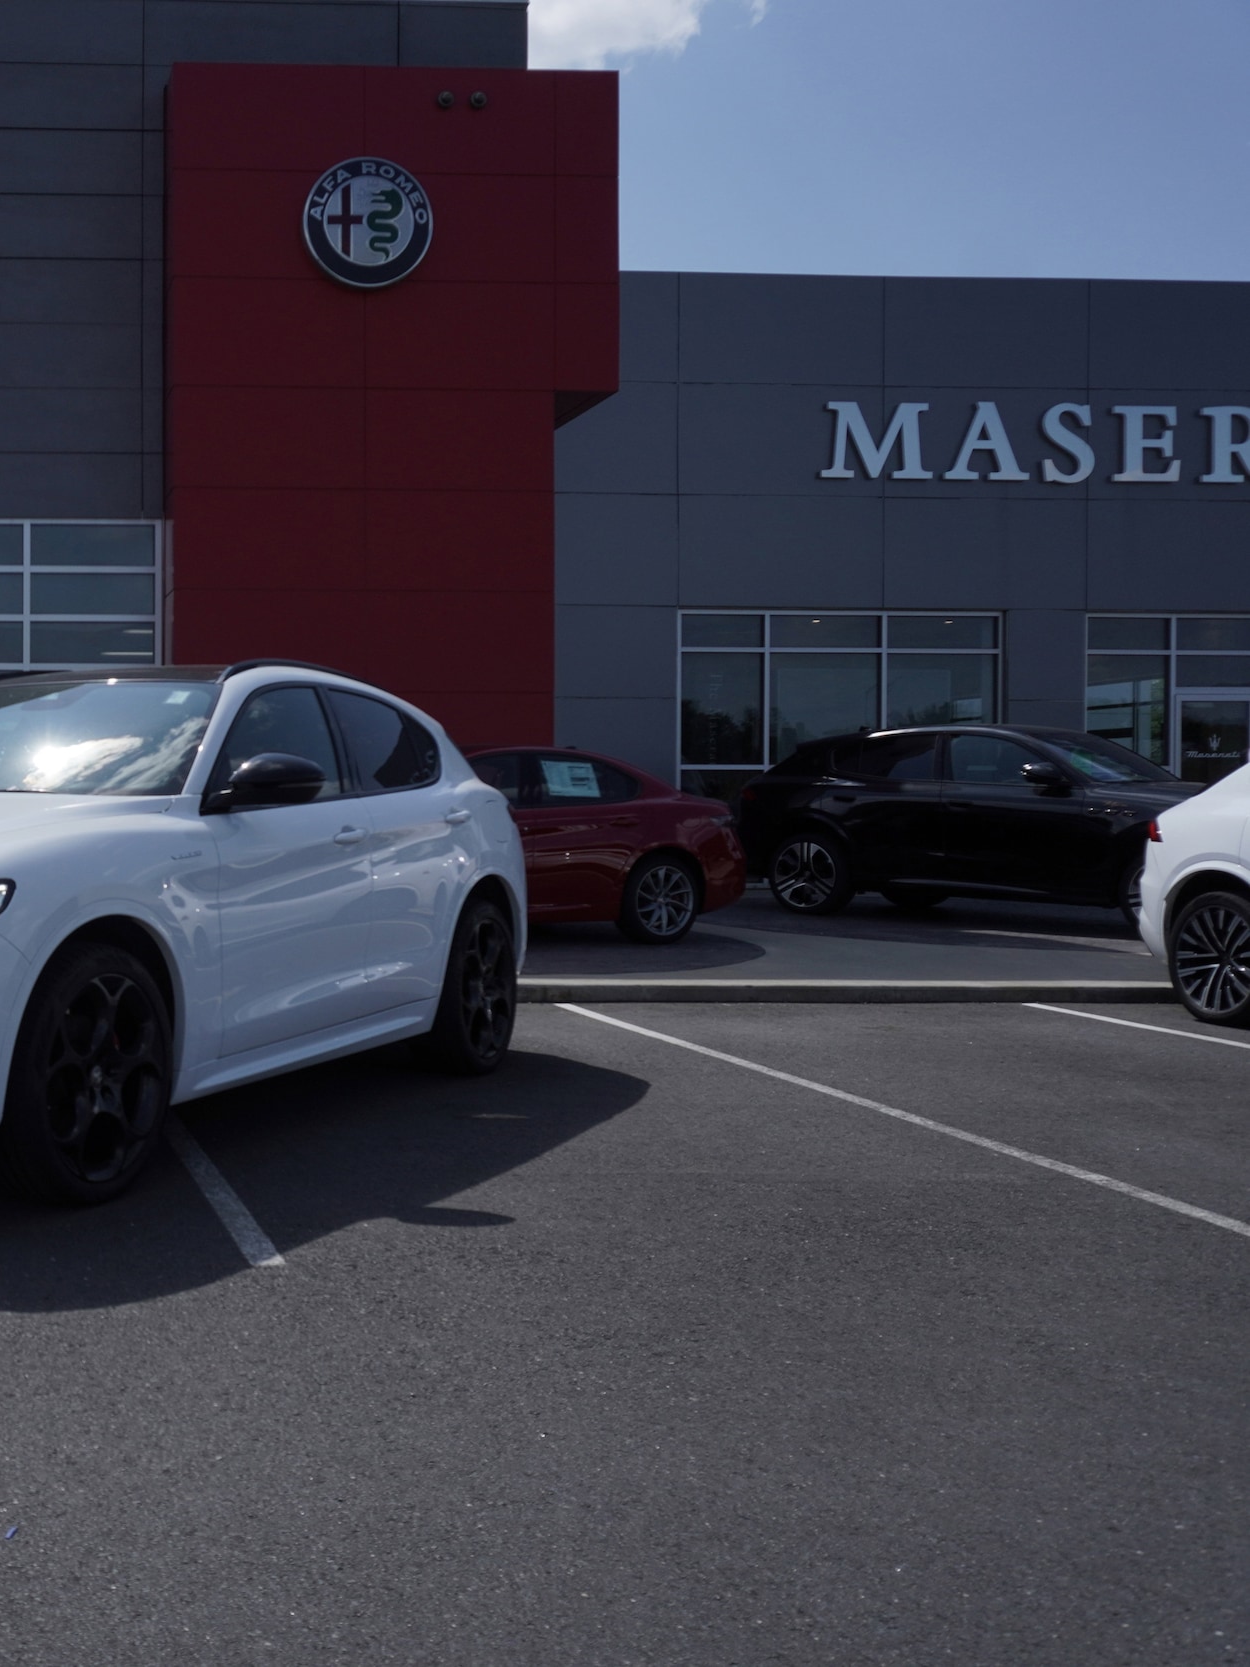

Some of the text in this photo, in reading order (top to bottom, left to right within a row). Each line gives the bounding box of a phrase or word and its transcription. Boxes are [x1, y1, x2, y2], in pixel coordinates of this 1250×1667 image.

[310, 162, 428, 225] ALFA ROMEO
[818, 400, 1250, 484] MASER
[1185, 750, 1241, 758] Maserati
